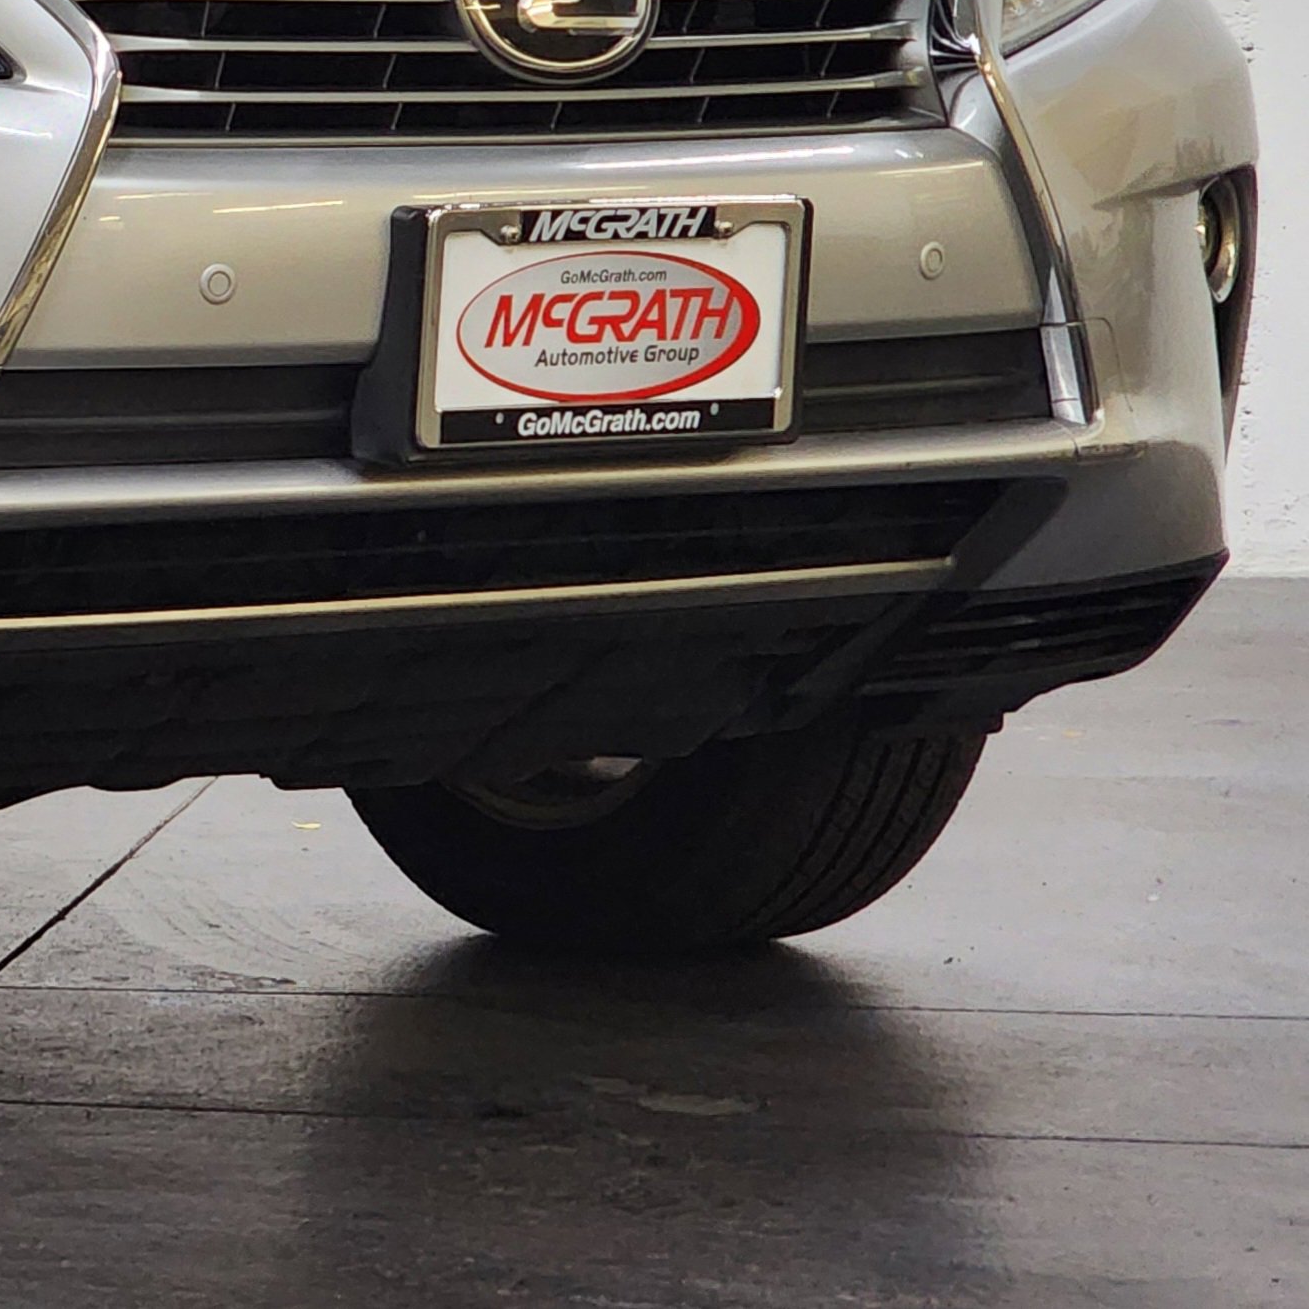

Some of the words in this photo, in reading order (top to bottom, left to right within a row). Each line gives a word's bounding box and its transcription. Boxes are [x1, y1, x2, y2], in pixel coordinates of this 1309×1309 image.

[560, 268, 667, 286] GoMcGrath.com
[534, 345, 639, 368] Automotive
[643, 345, 700, 367] Group
[517, 408, 700, 437] GoMcGrath.com
